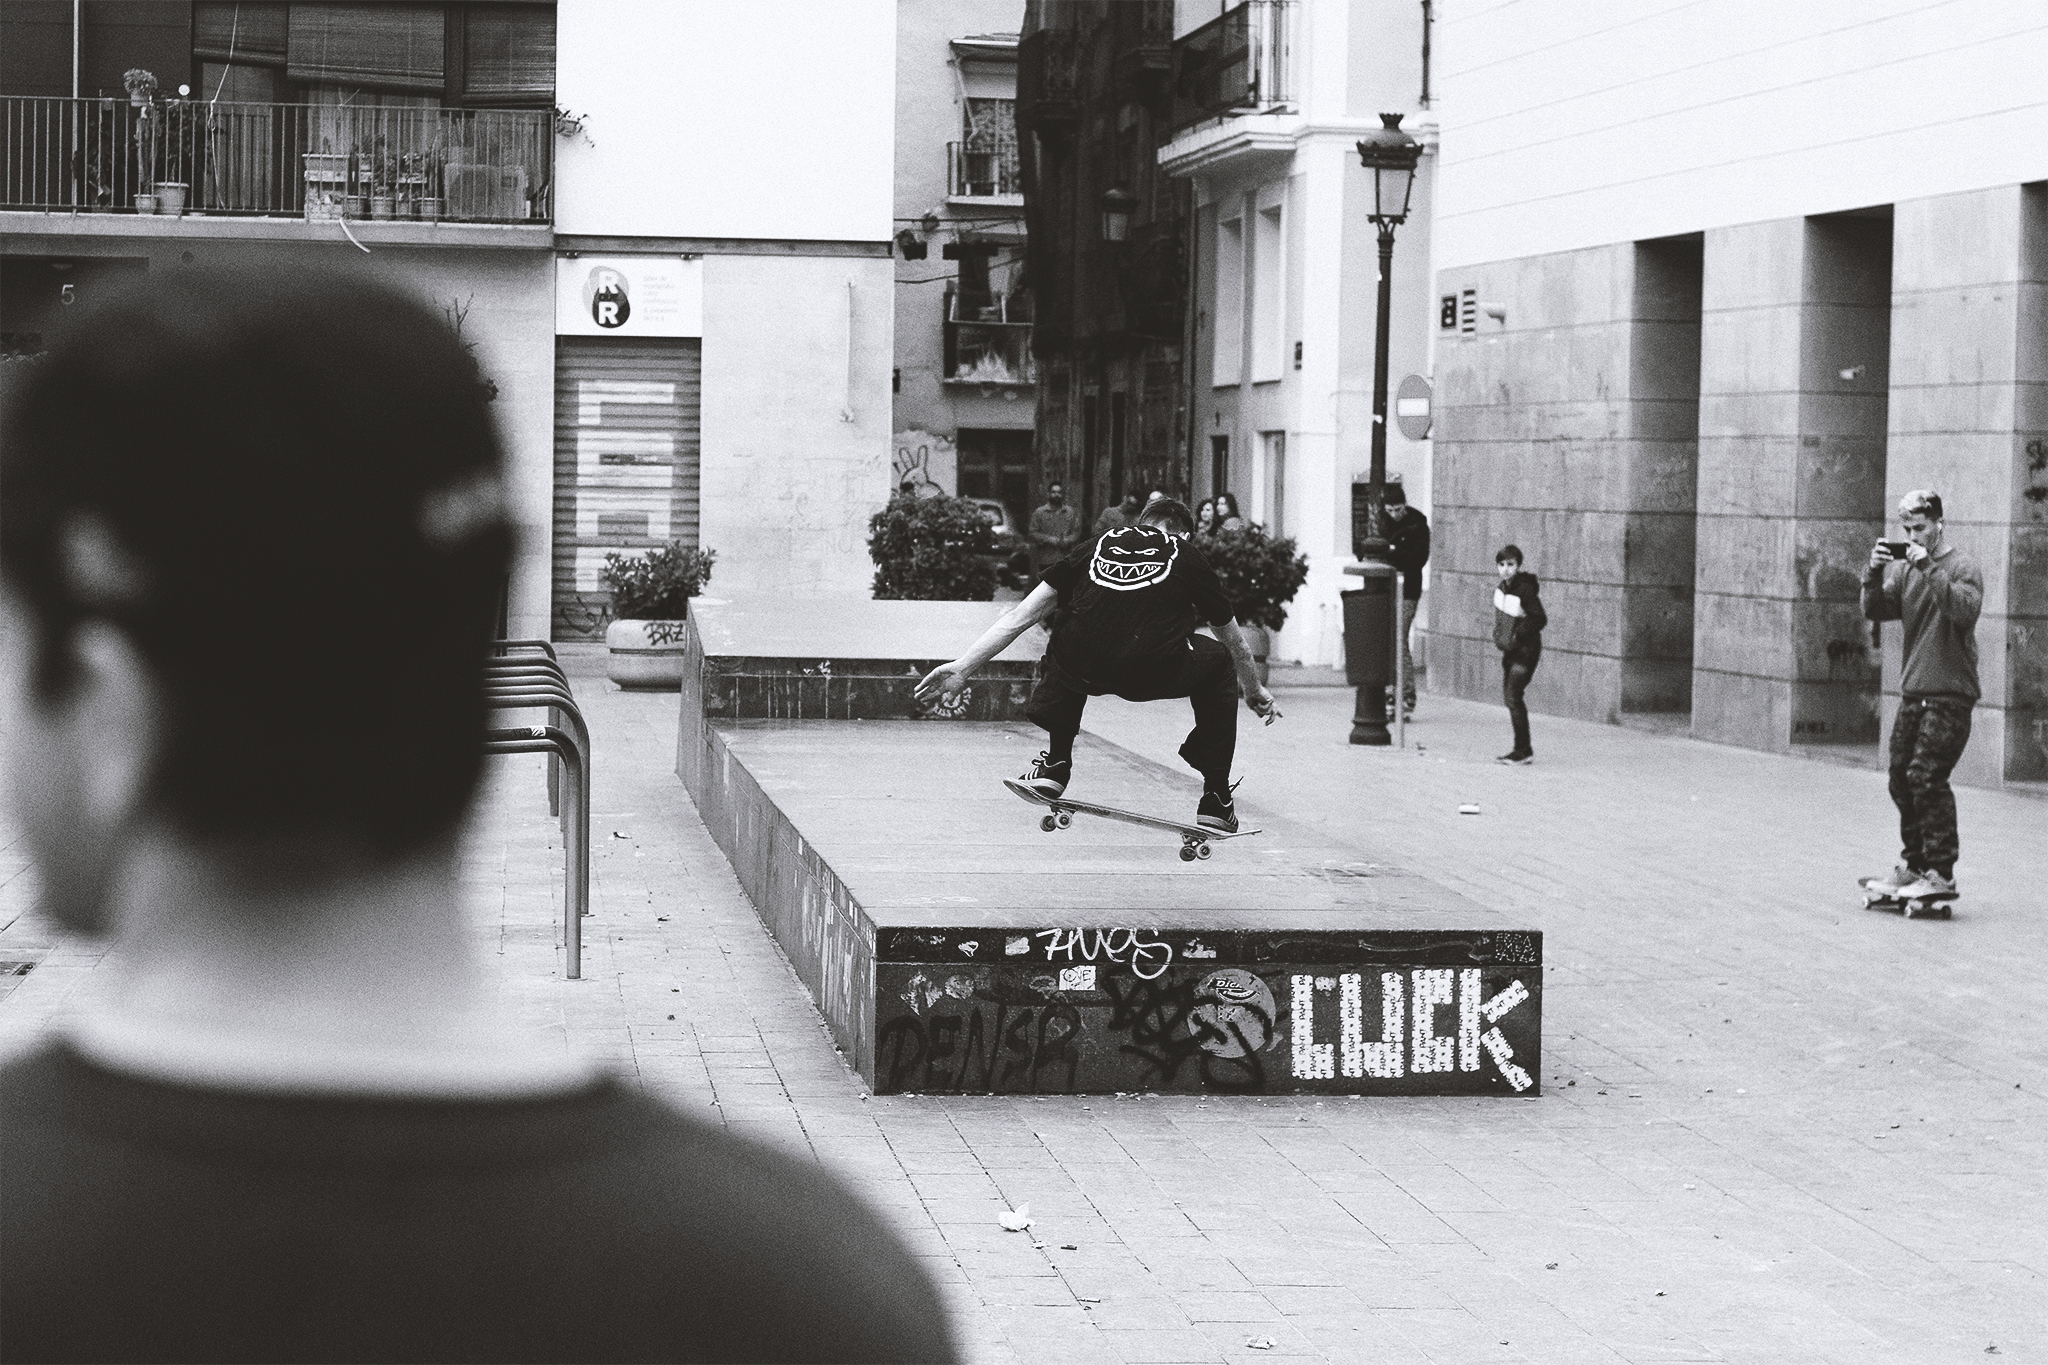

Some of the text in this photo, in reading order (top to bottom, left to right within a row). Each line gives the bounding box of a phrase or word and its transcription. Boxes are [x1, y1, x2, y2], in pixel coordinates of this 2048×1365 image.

[61, 284, 75, 305] 5
[598, 301, 619, 325] R
[1291, 968, 1534, 1092] LUCK
